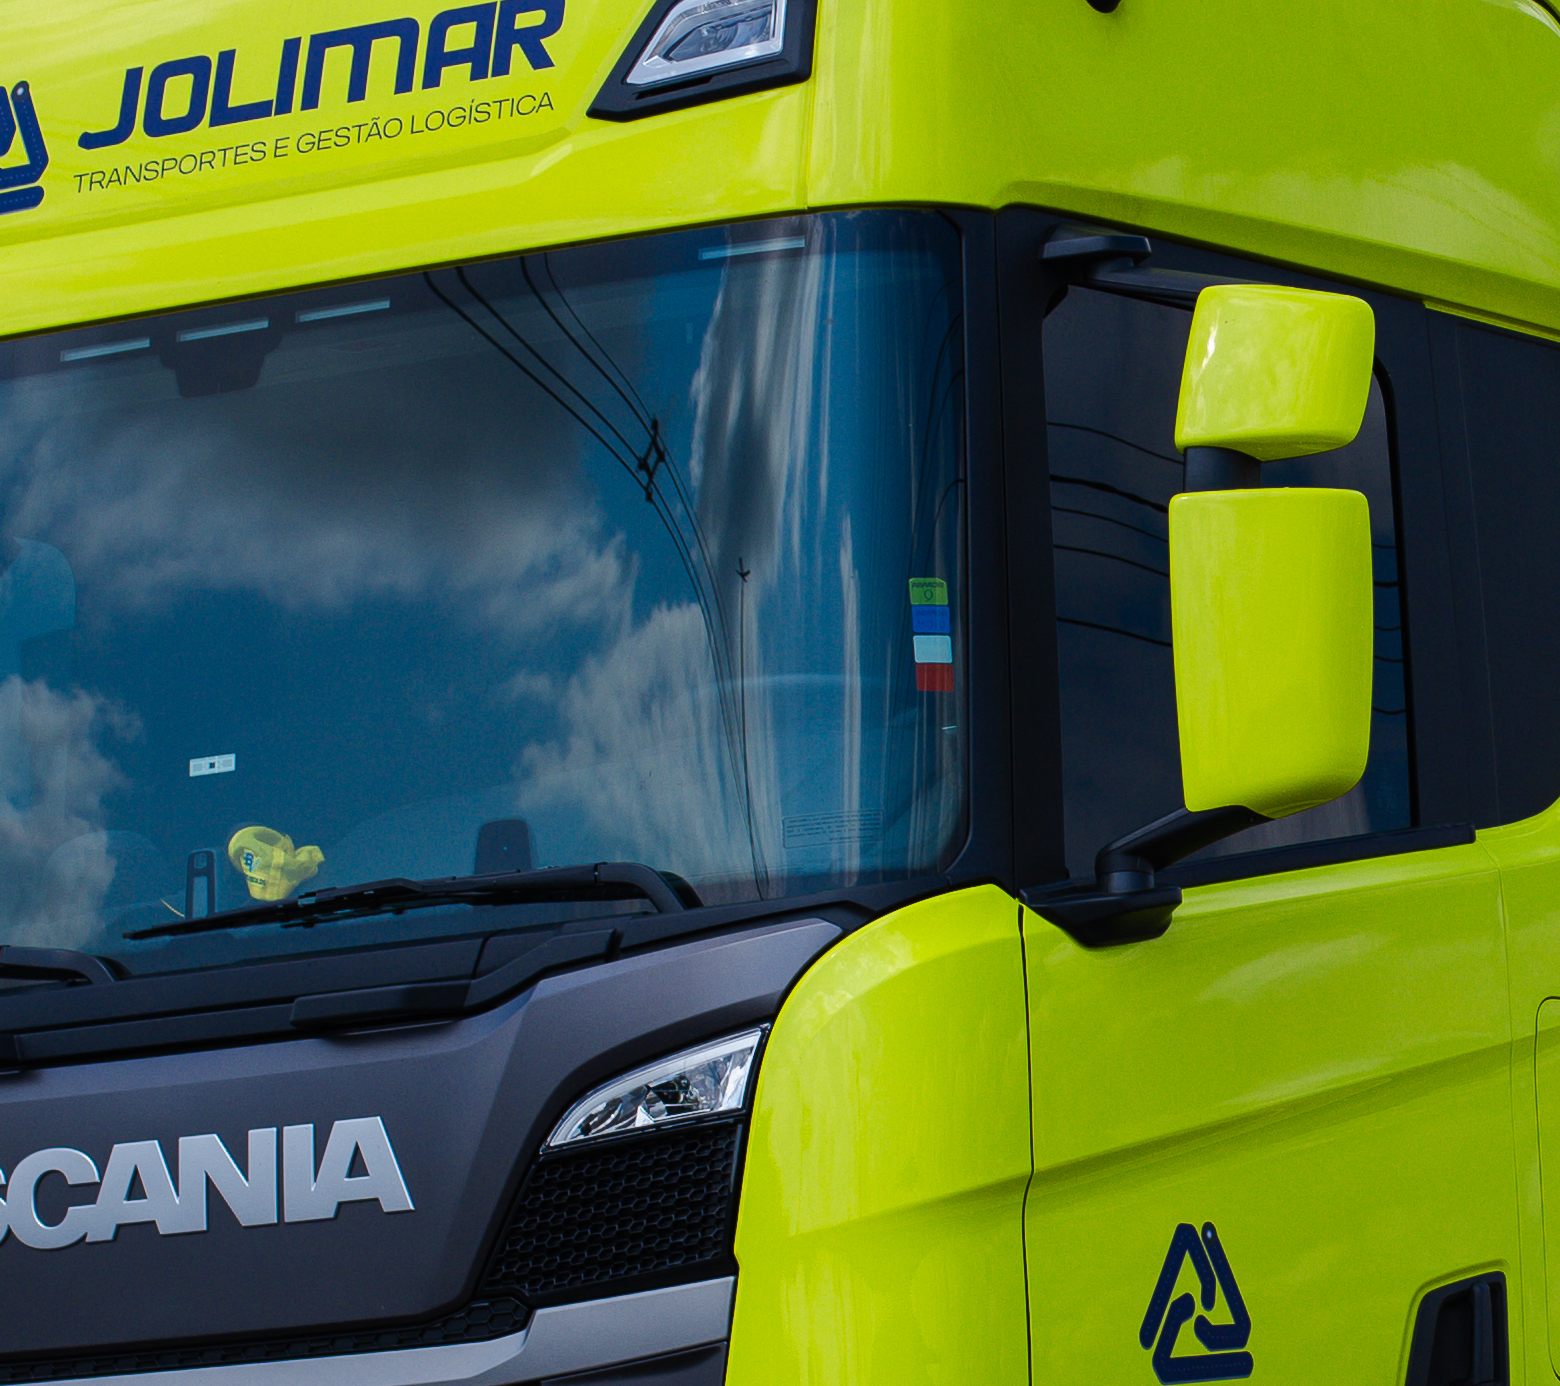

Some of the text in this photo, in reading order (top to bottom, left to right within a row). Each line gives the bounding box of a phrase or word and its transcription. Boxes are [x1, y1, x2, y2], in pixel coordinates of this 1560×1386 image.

[73, 92, 554, 194] TRANSPORTES E GESTÃO LOGÍSTICA
